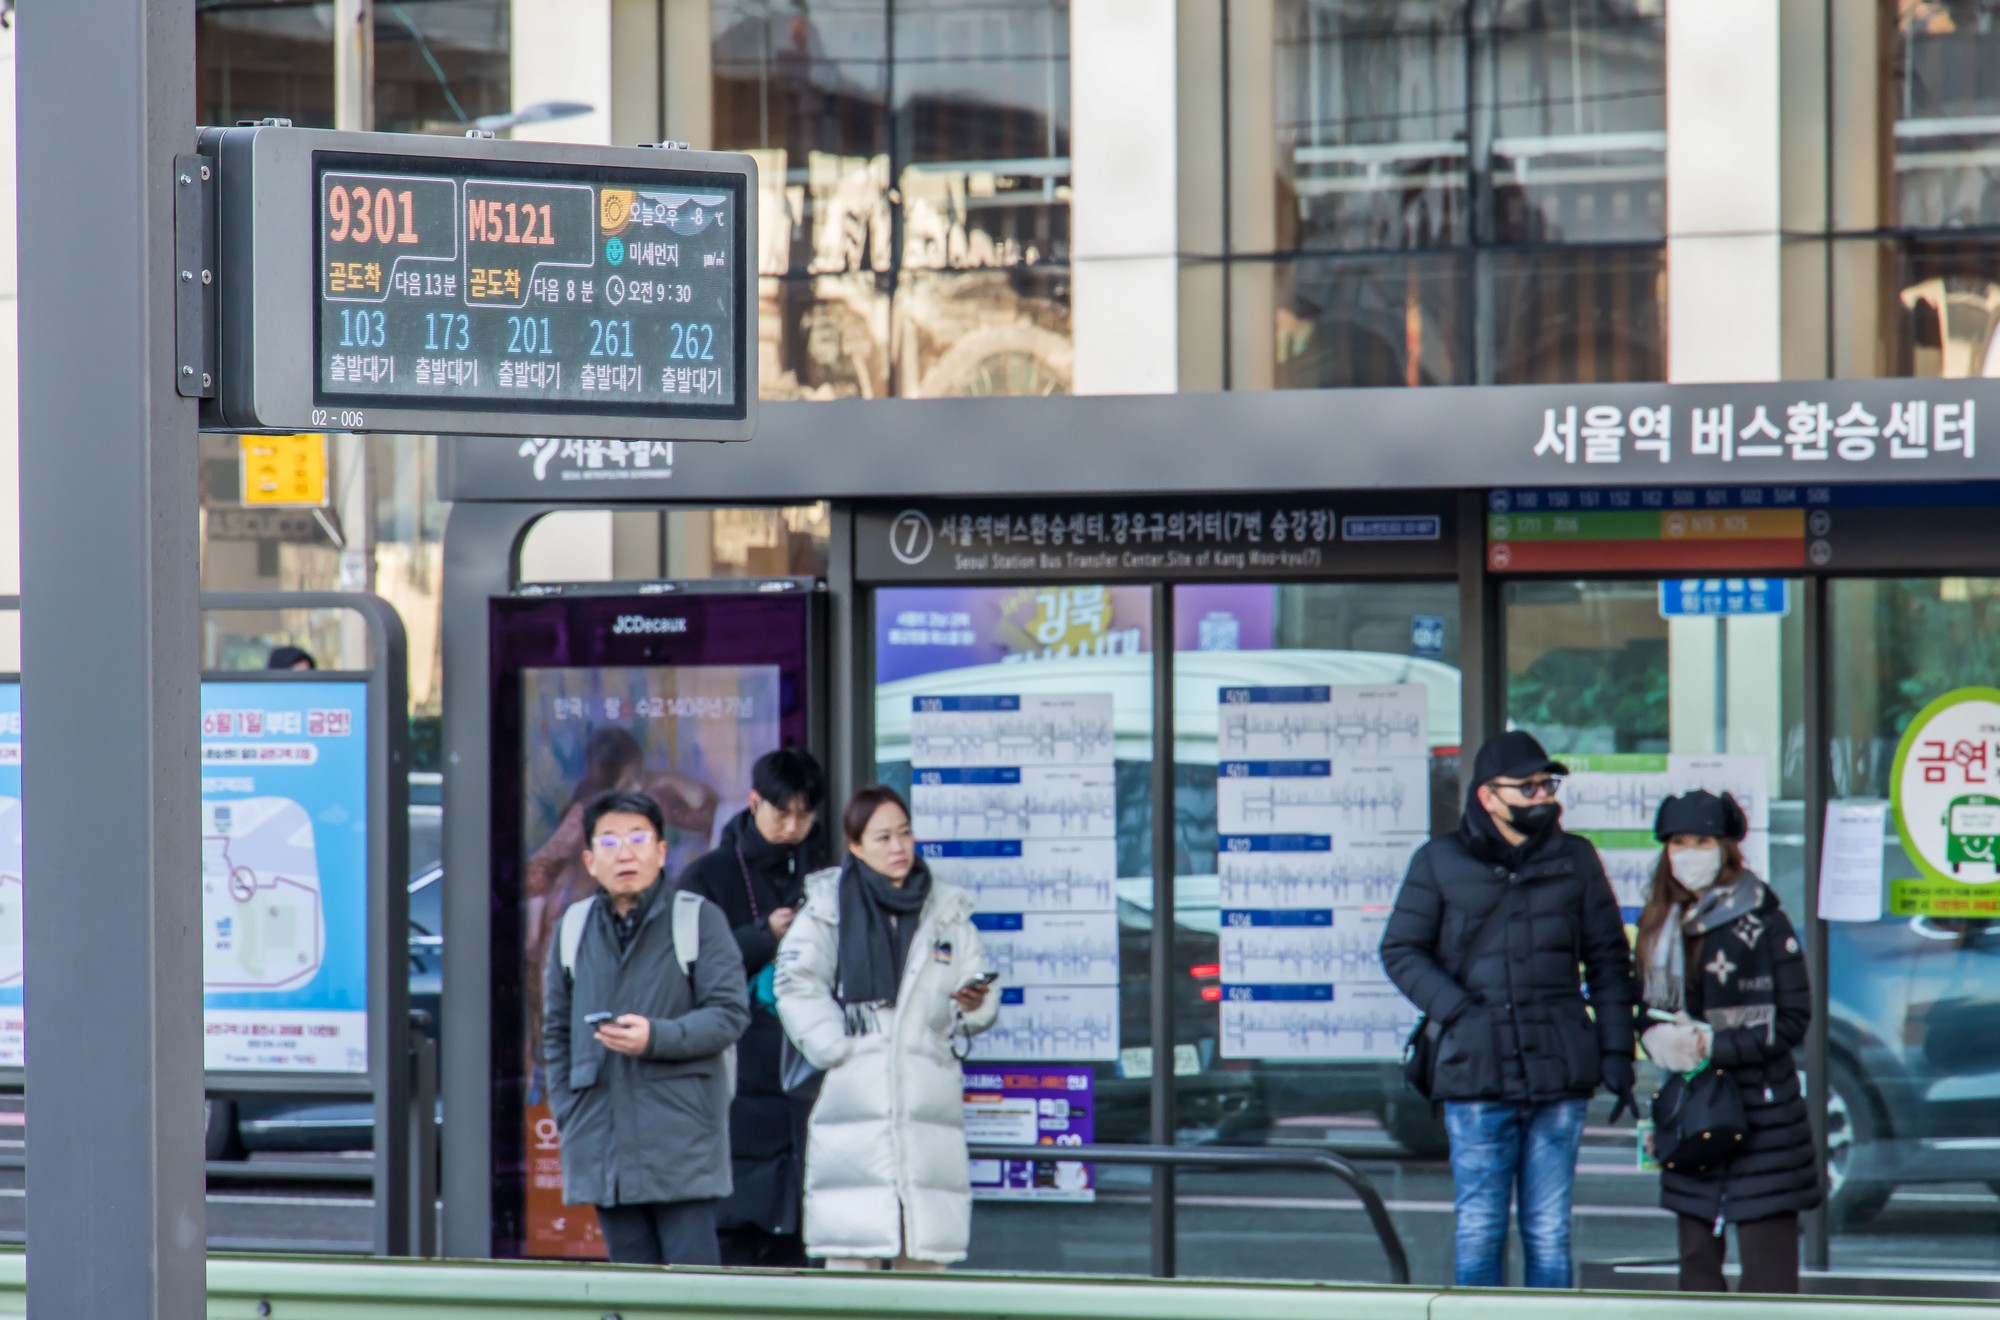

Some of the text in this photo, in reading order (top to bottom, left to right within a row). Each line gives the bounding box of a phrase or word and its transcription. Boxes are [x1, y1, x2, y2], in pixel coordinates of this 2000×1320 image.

[329, 185, 419, 244] 9301
[469, 199, 555, 245] M5121
[629, 242, 679, 267] 미세먼지
[329, 262, 382, 293] 곧도착
[395, 271, 422, 297] 다음
[470, 268, 521, 299] 곧도착
[534, 278, 559, 303] 다음
[627, 280, 653, 303] 오전
[339, 309, 386, 347] 103
[424, 312, 471, 351] 173
[507, 316, 553, 354] 201
[589, 319, 634, 357] 261
[670, 322, 715, 361] 262
[330, 354, 394, 384] 출발대기
[414, 357, 478, 386] 출발대기
[498, 360, 561, 390] 출발대기
[580, 363, 643, 393] 출발대기
[661, 365, 723, 395] 출발대기
[1533, 399, 1977, 464] 서울역 버스환승센터
[954, 553, 988, 570] Seoul
[992, 552, 1036, 569] Station
[1040, 552, 1062, 569] Bus
[1066, 551, 1118, 569] Transfer
[1196, 549, 1209, 567] of
[1213, 549, 1245, 569] Kang
[612, 615, 687, 634] JCDecaux
[1917, 740, 1986, 783] 금연
